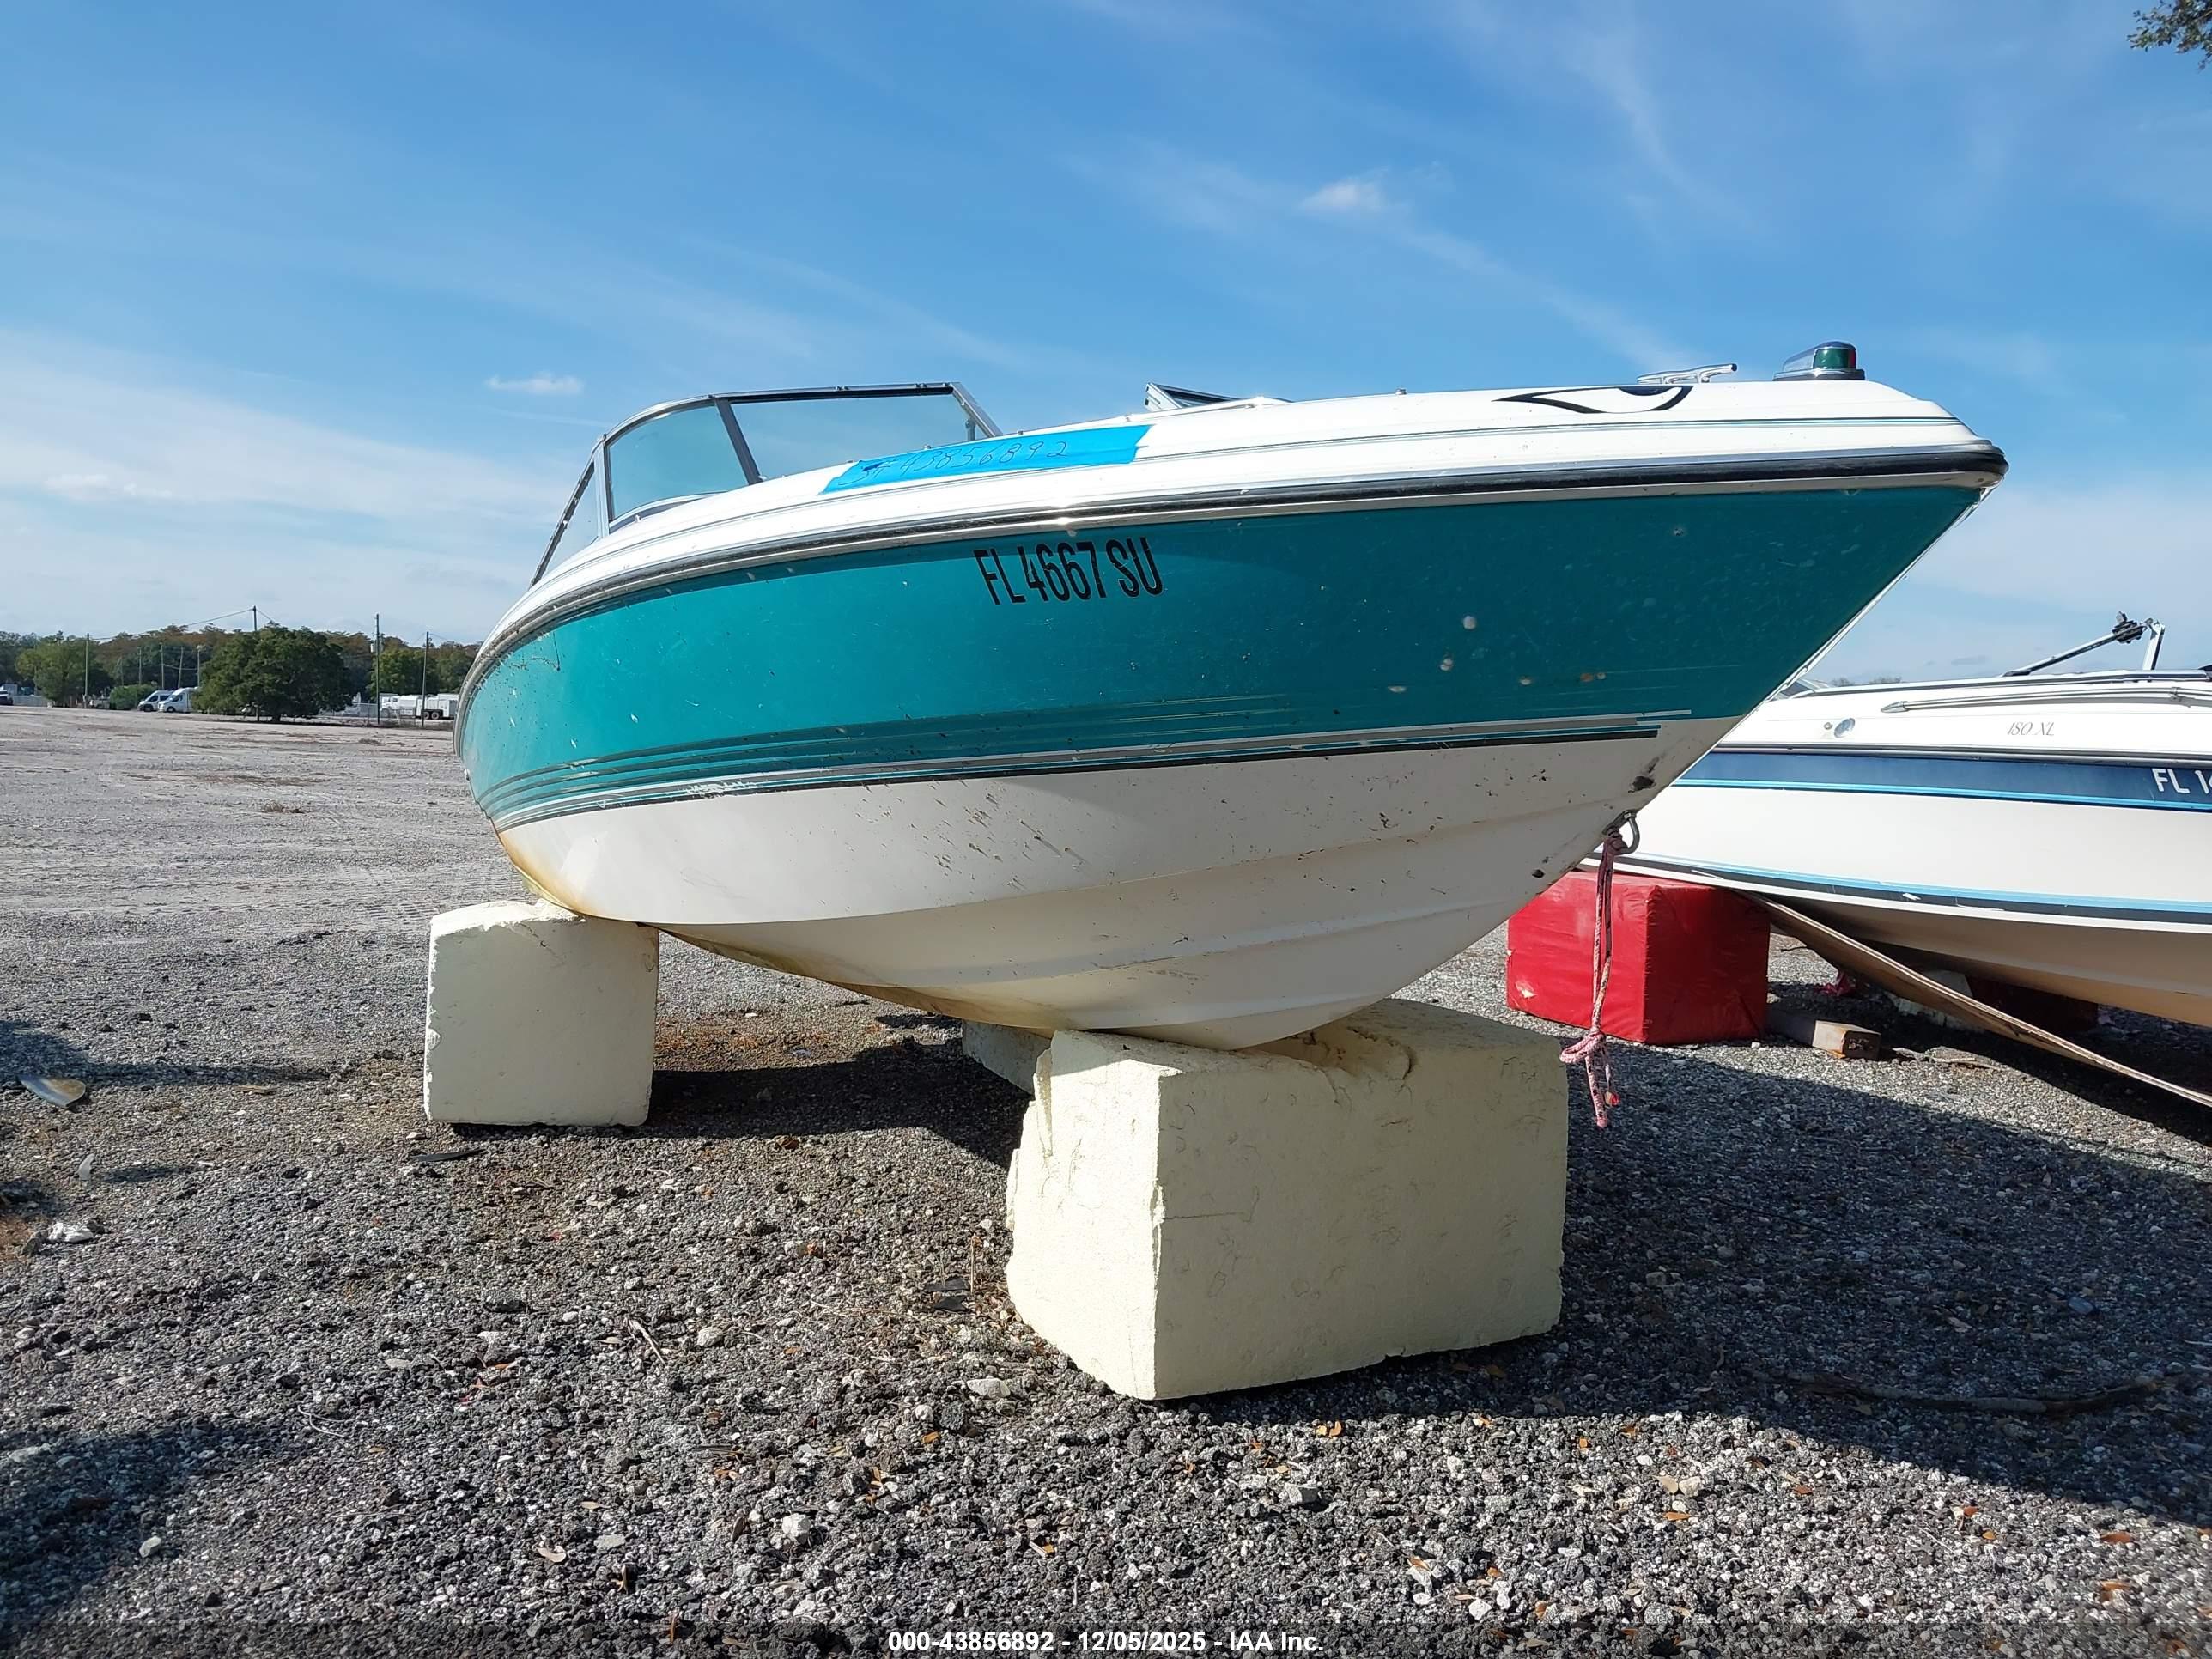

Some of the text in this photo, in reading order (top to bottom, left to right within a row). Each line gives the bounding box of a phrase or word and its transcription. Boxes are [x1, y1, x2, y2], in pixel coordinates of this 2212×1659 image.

[900, 441, 1067, 476] 43856892
[973, 536, 1163, 605] FL 4667 SU
[2007, 721, 2055, 737] 180 XL
[2151, 768, 2212, 794] FL 1
